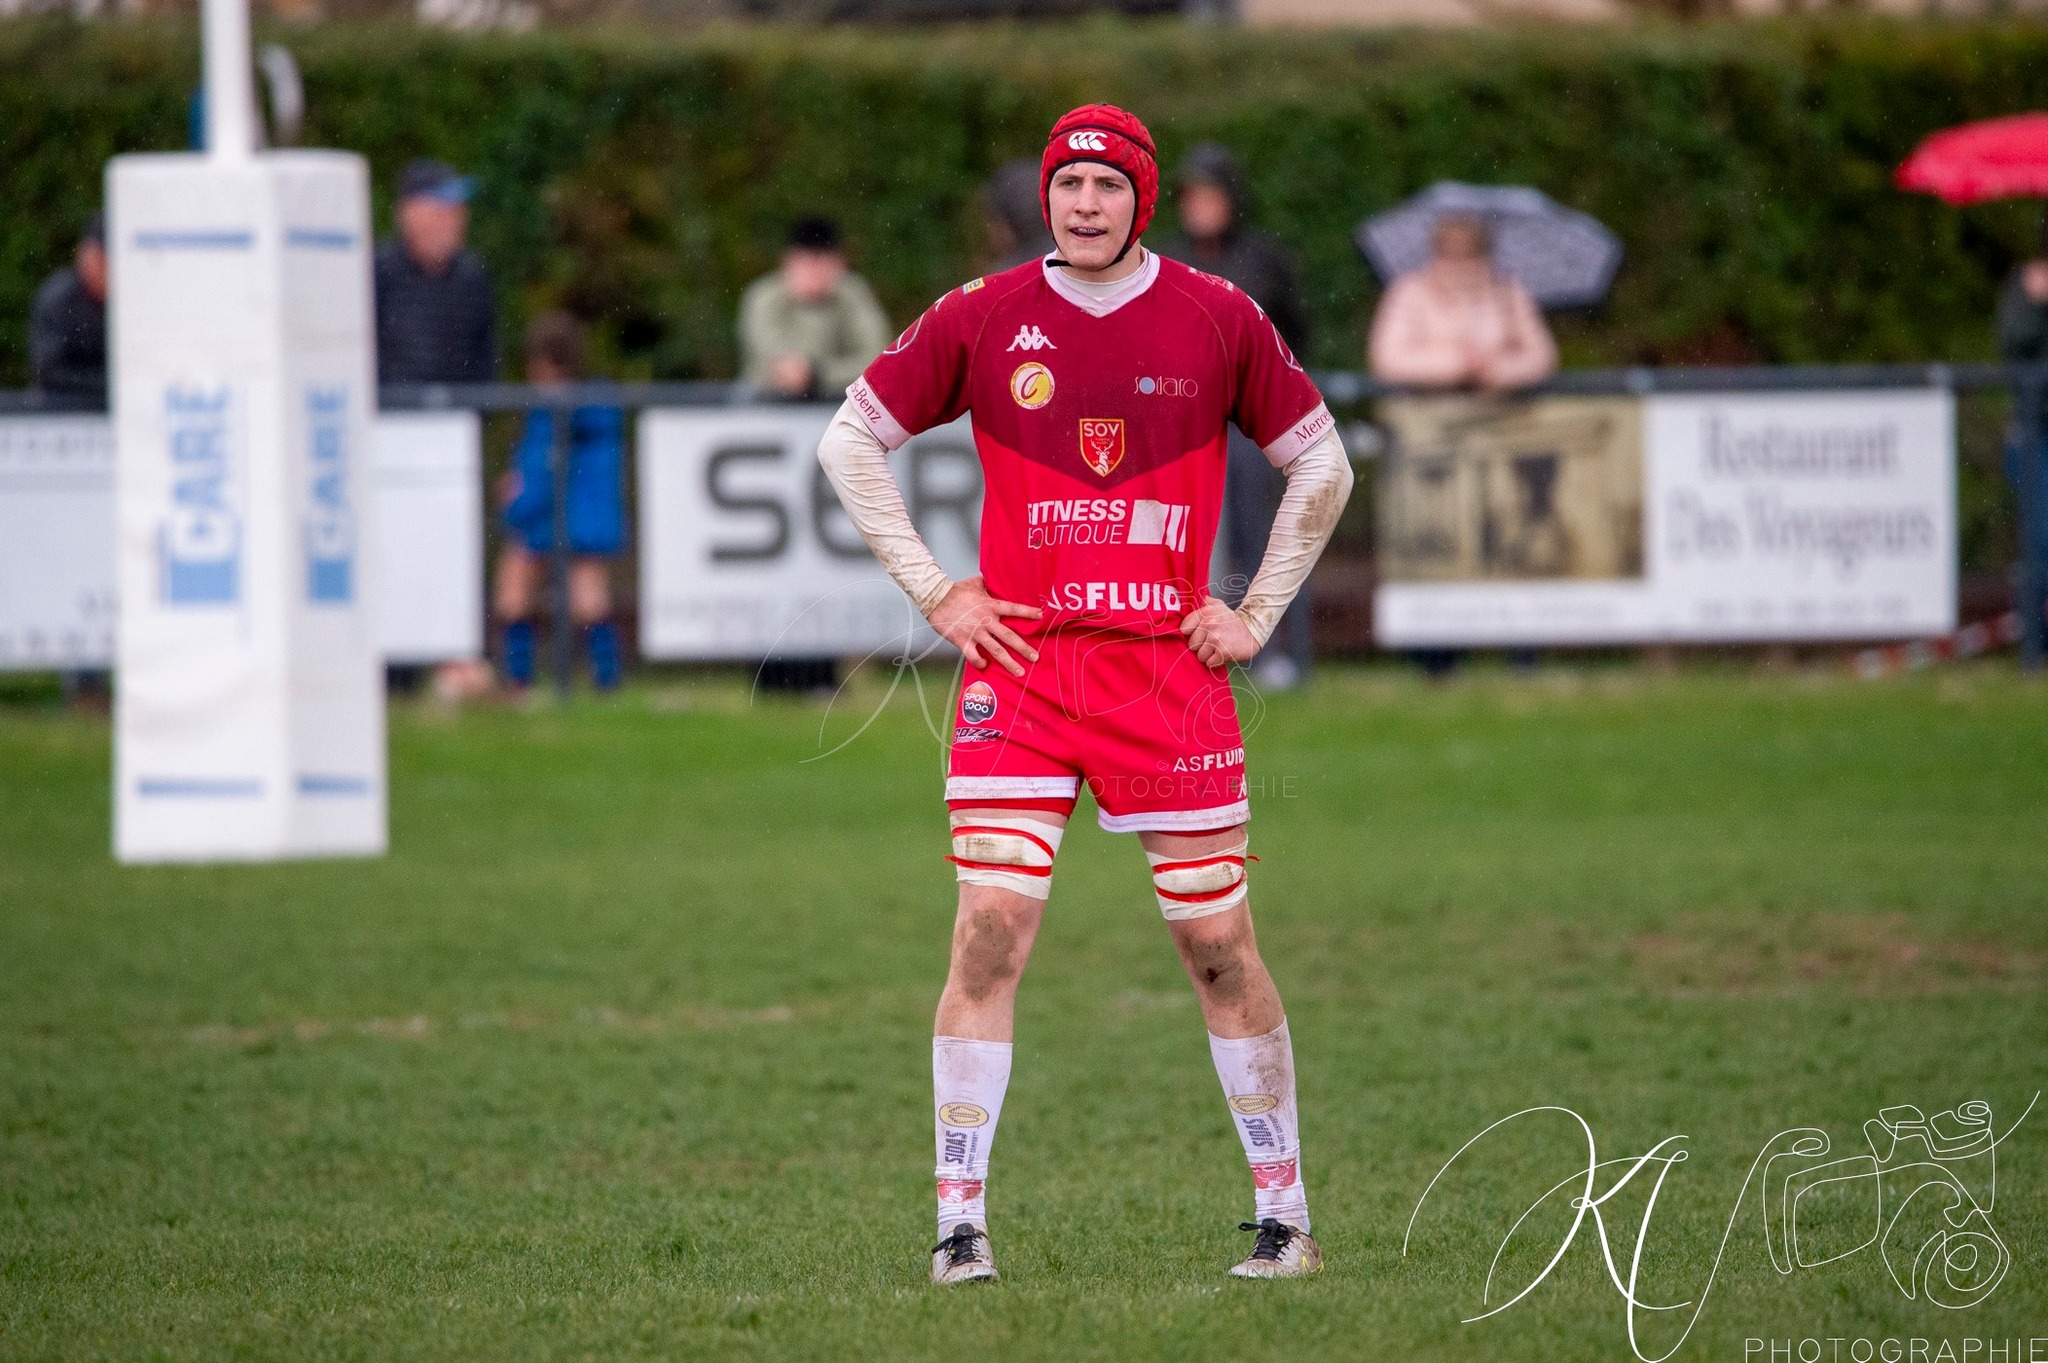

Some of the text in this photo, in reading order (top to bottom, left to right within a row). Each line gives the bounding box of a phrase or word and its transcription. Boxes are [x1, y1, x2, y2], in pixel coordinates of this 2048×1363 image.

[1083, 422, 1119, 437] SOV
[965, 693, 993, 704] SPORT
[965, 702, 989, 713] 2000
[1173, 747, 1245, 772] ASFLUID
[1242, 1117, 1275, 1147] SIDAS
[945, 1130, 967, 1164] SIDAS
